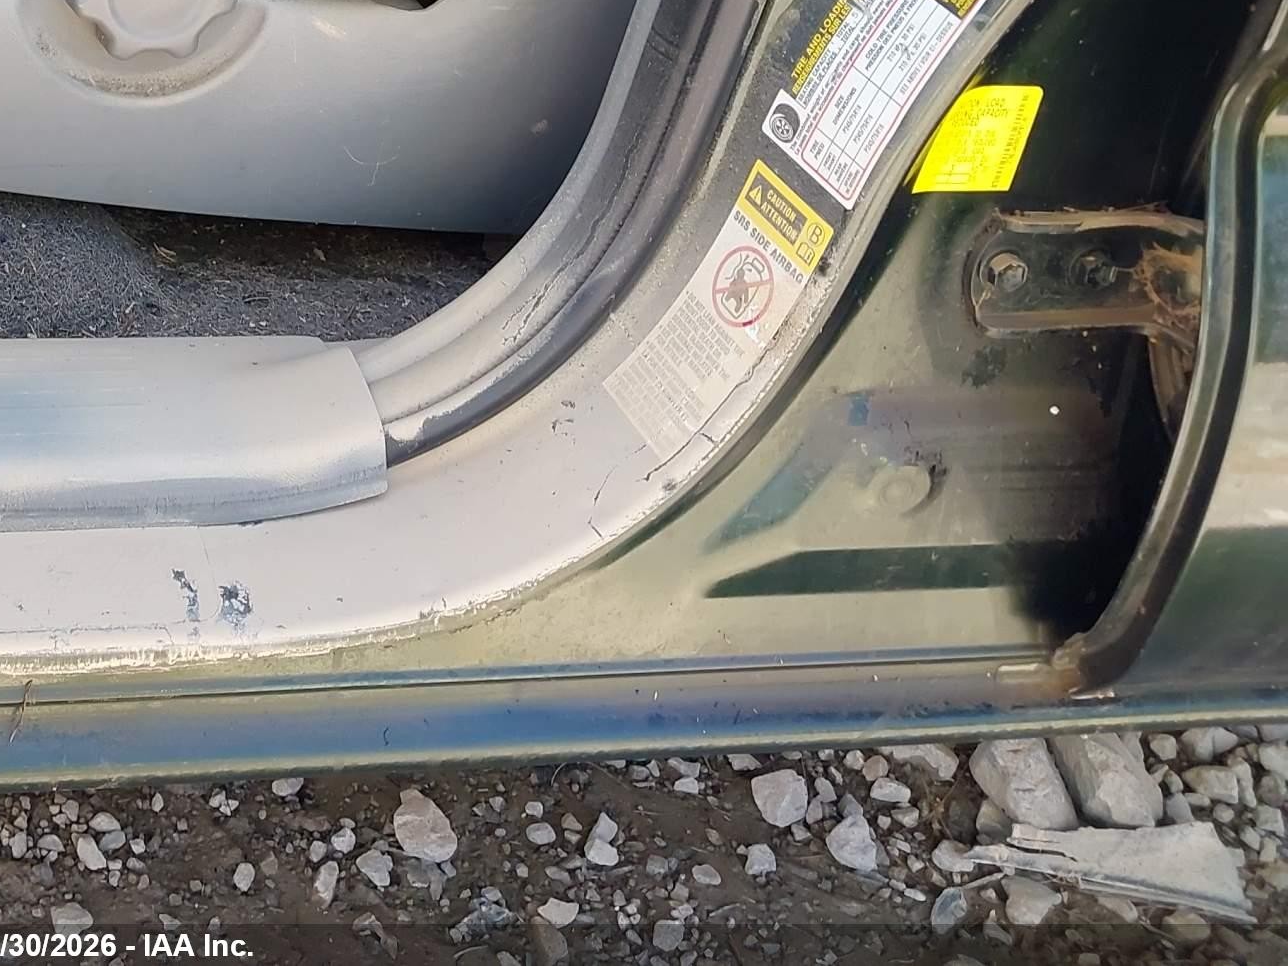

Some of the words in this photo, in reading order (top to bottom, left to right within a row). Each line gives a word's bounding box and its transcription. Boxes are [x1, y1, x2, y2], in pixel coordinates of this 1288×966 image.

[828, 18, 841, 34] SUR
[838, 4, 851, 19] LES
[791, 56, 808, 79] TIRE
[806, 34, 822, 55] AND
[761, 202, 798, 241] ATTENTION
[767, 189, 797, 222] CAUTION
[750, 227, 771, 251] SIDE
[770, 248, 804, 284] AIRBAG
